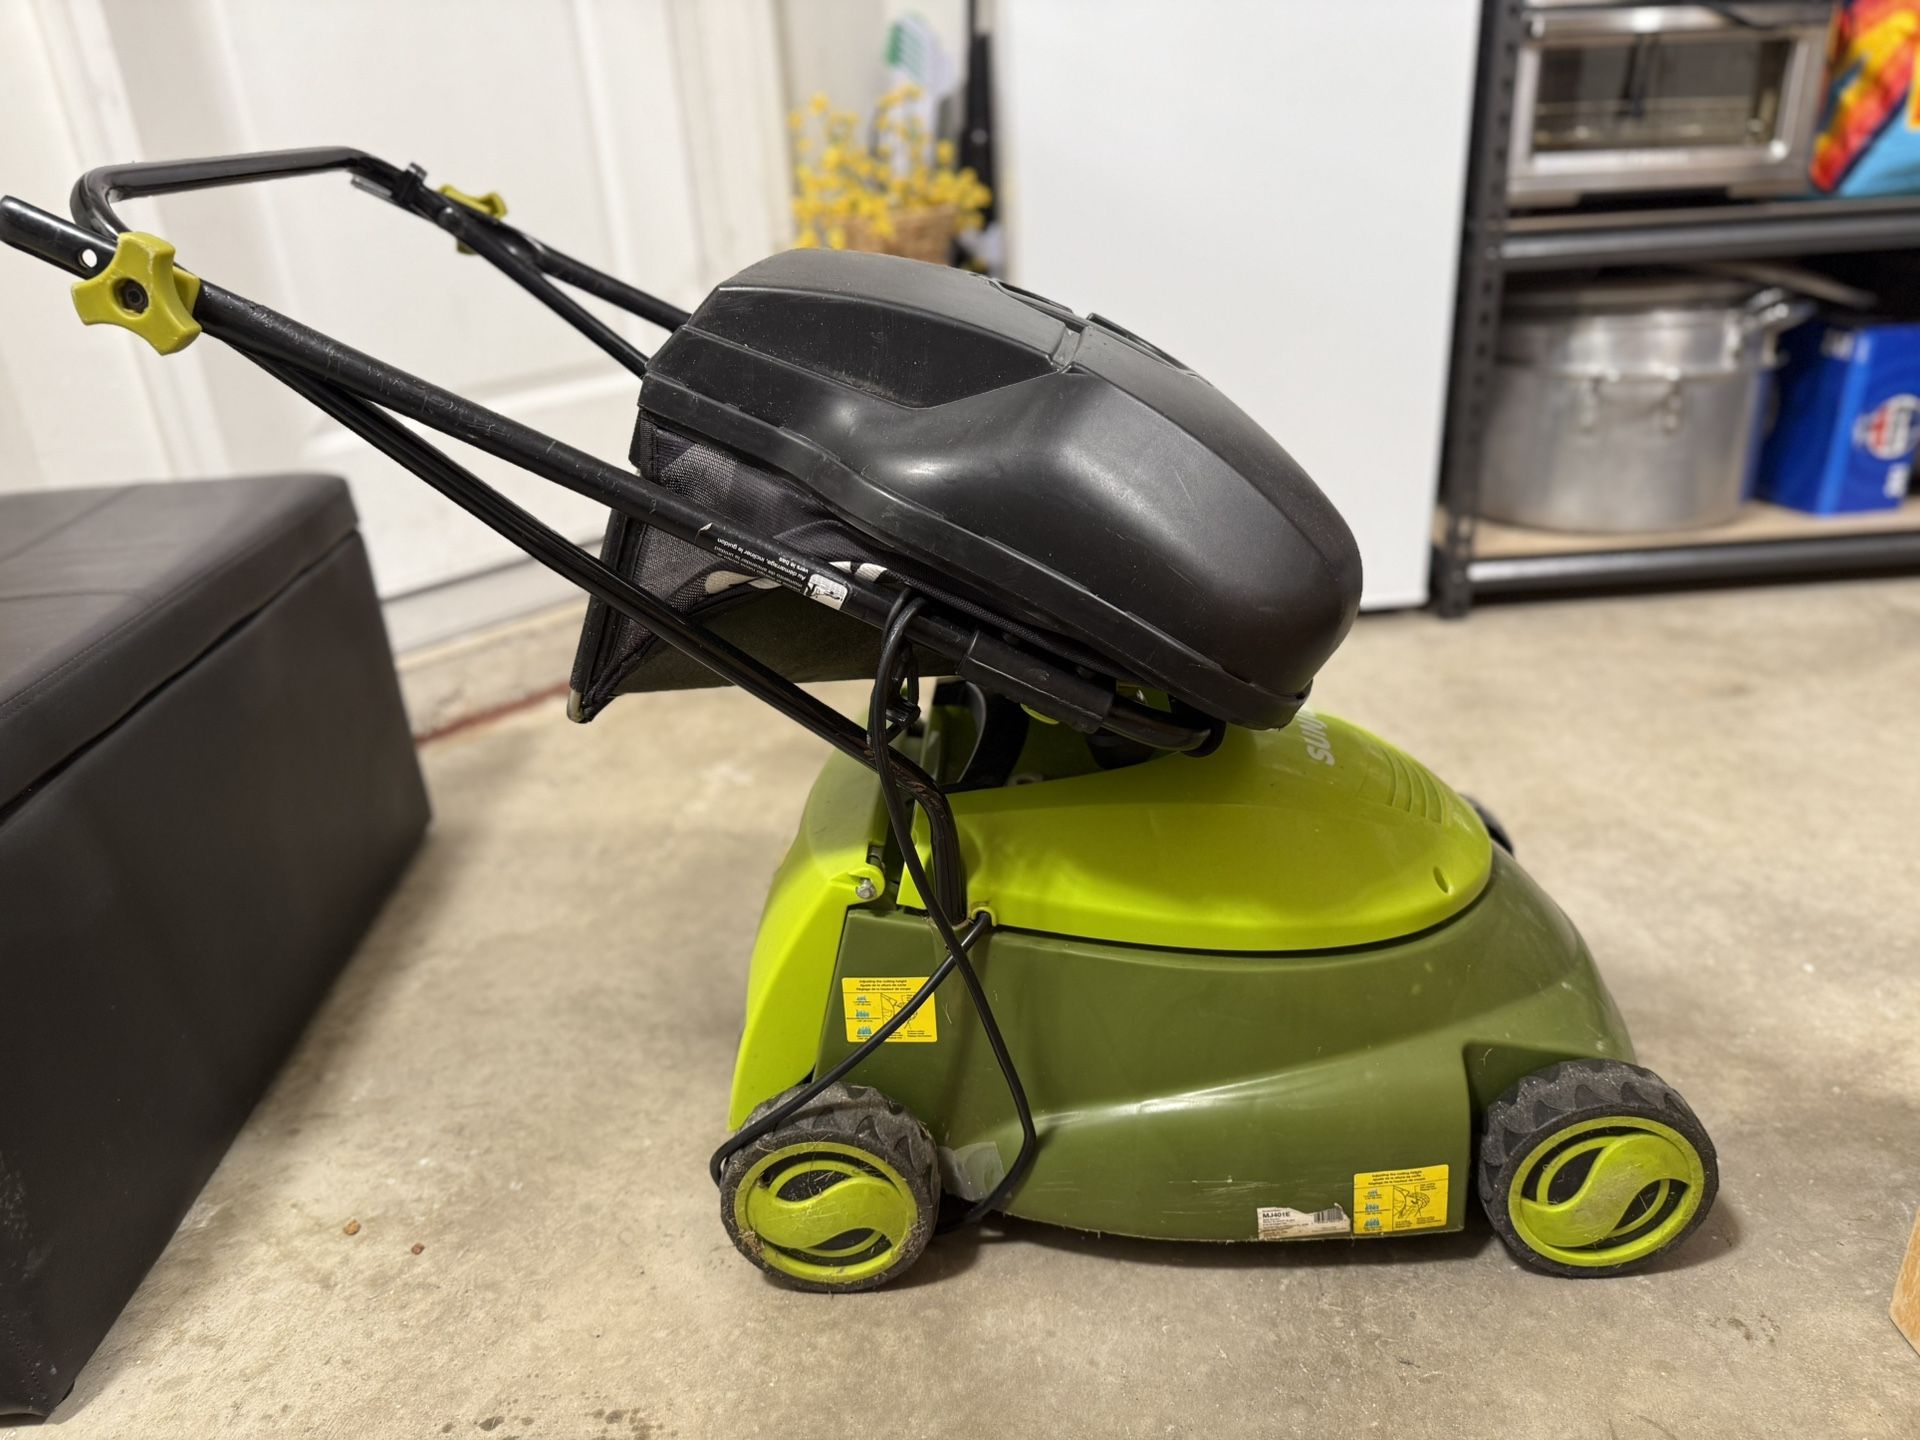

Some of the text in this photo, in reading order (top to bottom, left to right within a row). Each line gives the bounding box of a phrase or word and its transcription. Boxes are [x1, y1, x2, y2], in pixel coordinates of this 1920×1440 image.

[717, 537, 738, 550] guidon
[744, 550, 765, 562] incliner
[778, 557, 790, 565] bas
[796, 565, 809, 573] vers
